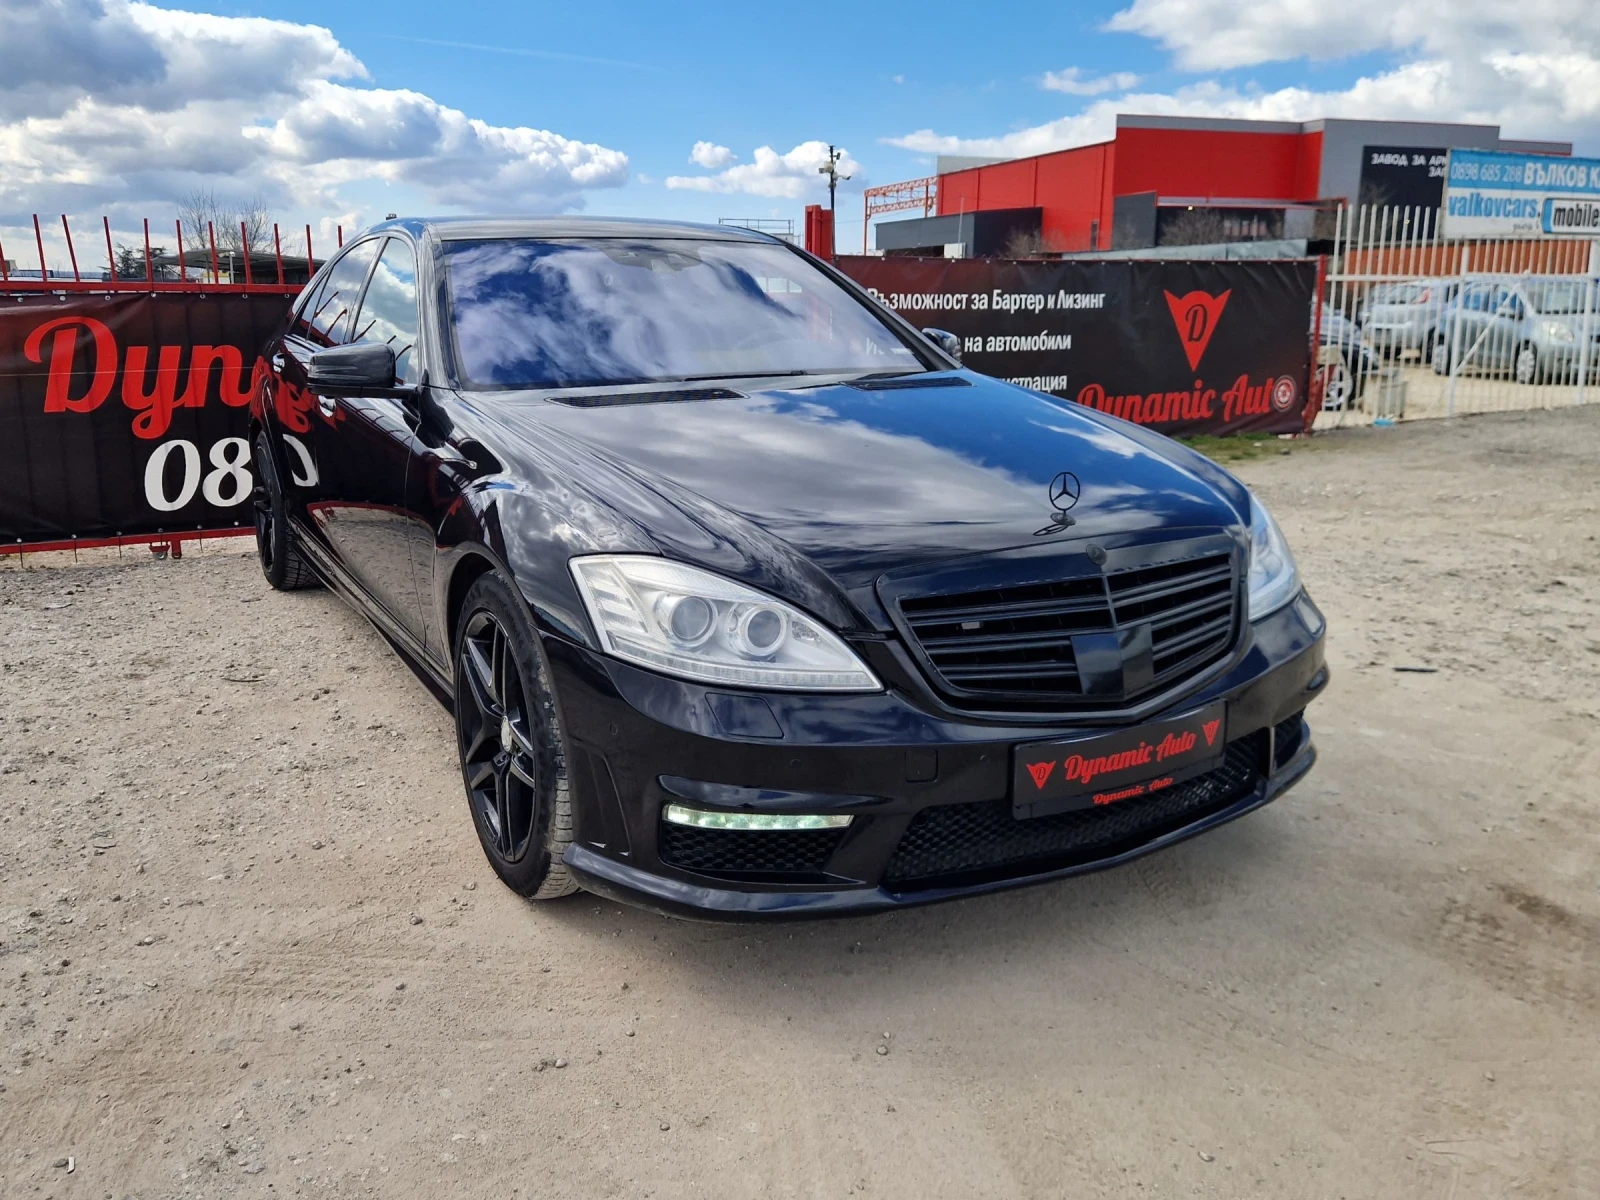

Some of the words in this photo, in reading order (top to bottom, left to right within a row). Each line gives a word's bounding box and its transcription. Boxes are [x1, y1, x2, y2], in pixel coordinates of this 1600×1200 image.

[1371, 153, 1408, 166] ЗАВОД
[1412, 155, 1426, 166] ЗА
[1524, 162, 1587, 187] ВЪЛКОВ
[970, 293, 989, 310] за
[992, 289, 1045, 315] Бартер
[1047, 294, 1056, 309] и
[1056, 289, 1106, 309] Лизинг
[964, 336, 982, 352] на
[986, 329, 1072, 352] автомобили
[1064, 741, 1153, 784] Dynamic
[1156, 731, 1197, 763] Auto
[1092, 785, 1145, 805] Dynamic
[1148, 777, 1174, 791] Auto
